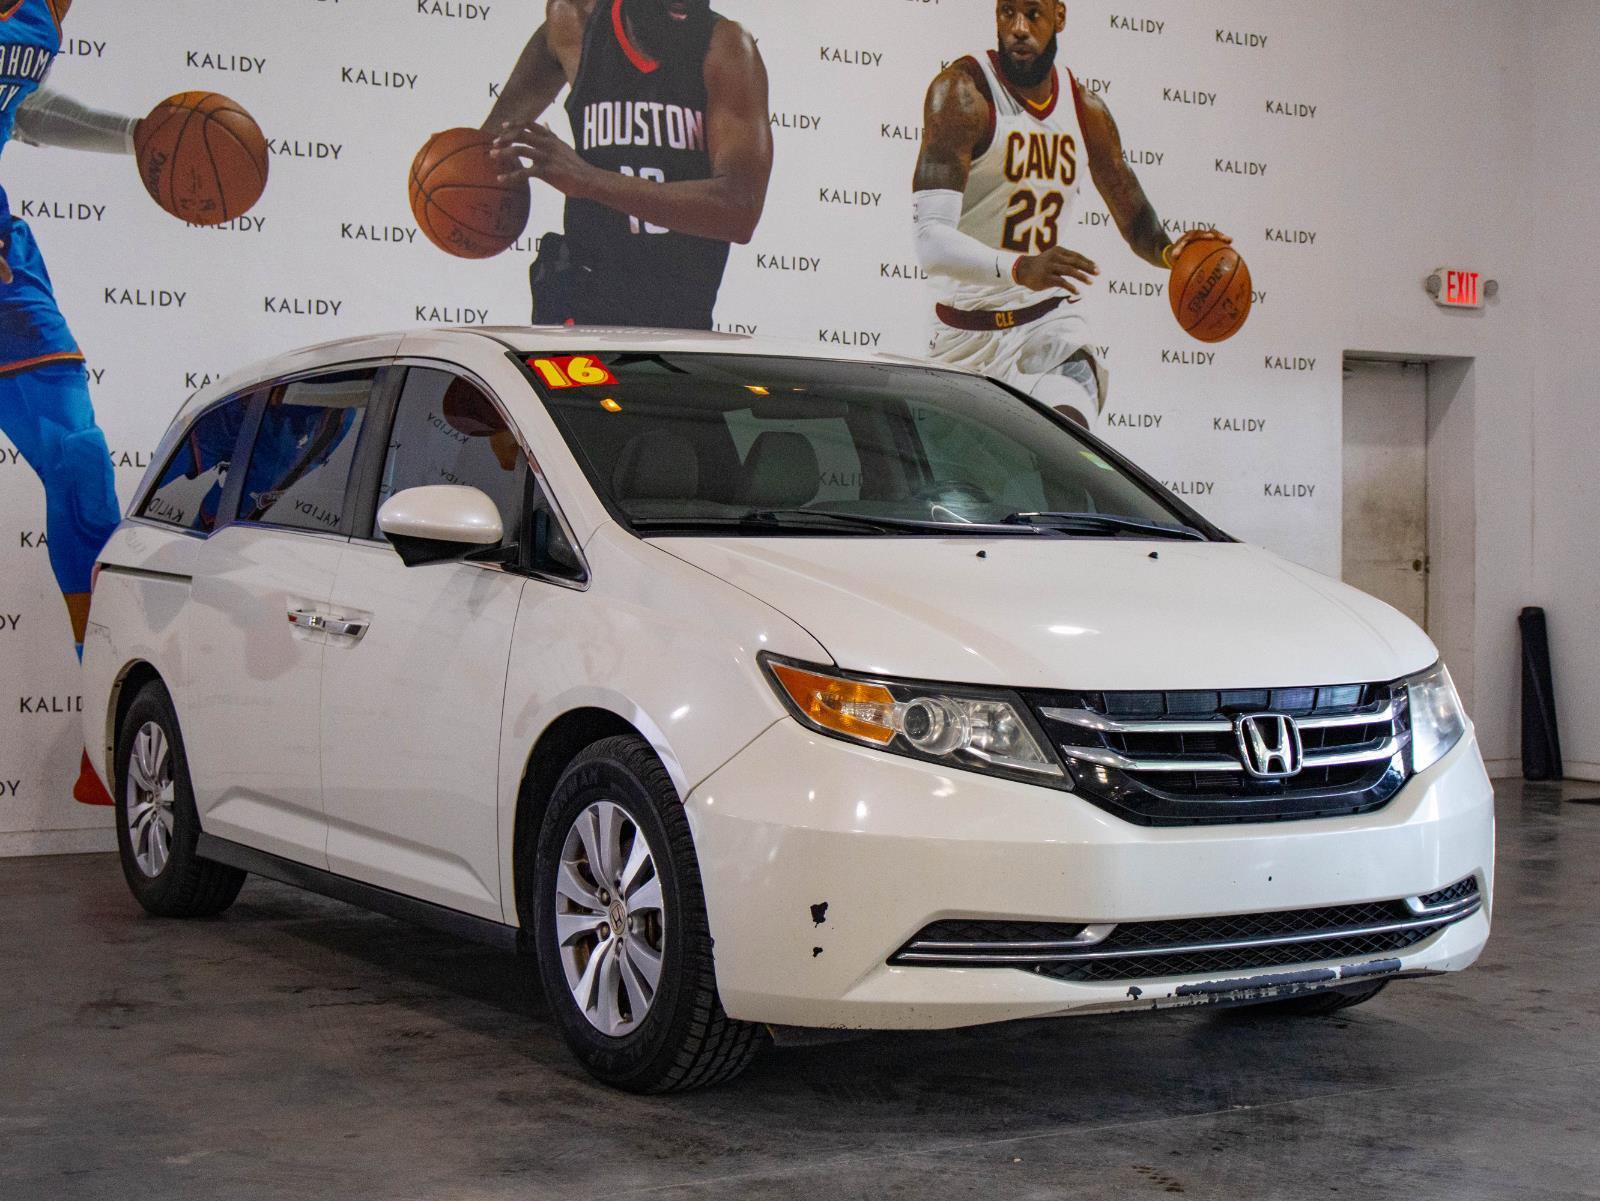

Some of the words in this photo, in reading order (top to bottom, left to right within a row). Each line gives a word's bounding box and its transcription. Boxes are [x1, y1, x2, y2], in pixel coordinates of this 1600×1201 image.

[416, 0, 490, 20] KALIDY
[1110, 15, 1164, 34] KALIDY
[1215, 30, 1268, 48] KALIDY
[58, 39, 106, 58] IDY
[820, 47, 882, 67] KALIDY
[186, 51, 266, 74] KALIDY
[341, 66, 418, 89] KALIDY
[1077, 77, 1111, 93] IDY
[1163, 88, 1217, 106] KALIDY
[1265, 101, 1317, 118] KALIDY
[583, 101, 705, 151] HOUSTON
[769, 113, 821, 130] ALIDY
[881, 124, 926, 141] KALI
[266, 138, 343, 160] KALIDY
[1122, 150, 1164, 166] ALIDY
[1004, 131, 1077, 187] CAVS
[1215, 159, 1268, 176] KALIDY
[820, 188, 882, 206] KALIDY
[21, 200, 106, 221] KALIDY
[1078, 211, 1111, 227] IDY
[1001, 189, 1064, 254] 23
[341, 222, 417, 243] KALIDY
[1265, 228, 1317, 245] KALIDY
[757, 254, 821, 271] KALIDY
[1108, 280, 1164, 297] KALIDY
[1447, 271, 1479, 305] EXIT
[104, 287, 187, 308] KALIDY
[264, 296, 342, 316] KALIDY
[415, 305, 489, 324] KALIDY
[995, 311, 1015, 328] CLE
[819, 329, 881, 347] KALIDY
[1161, 349, 1216, 366] KALIDY
[1264, 356, 1316, 371] KALIDY
[534, 356, 609, 387] 16
[1107, 412, 1162, 428] KALIDY
[1213, 417, 1266, 432] KALIDY
[1264, 483, 1316, 498] KALIDY
